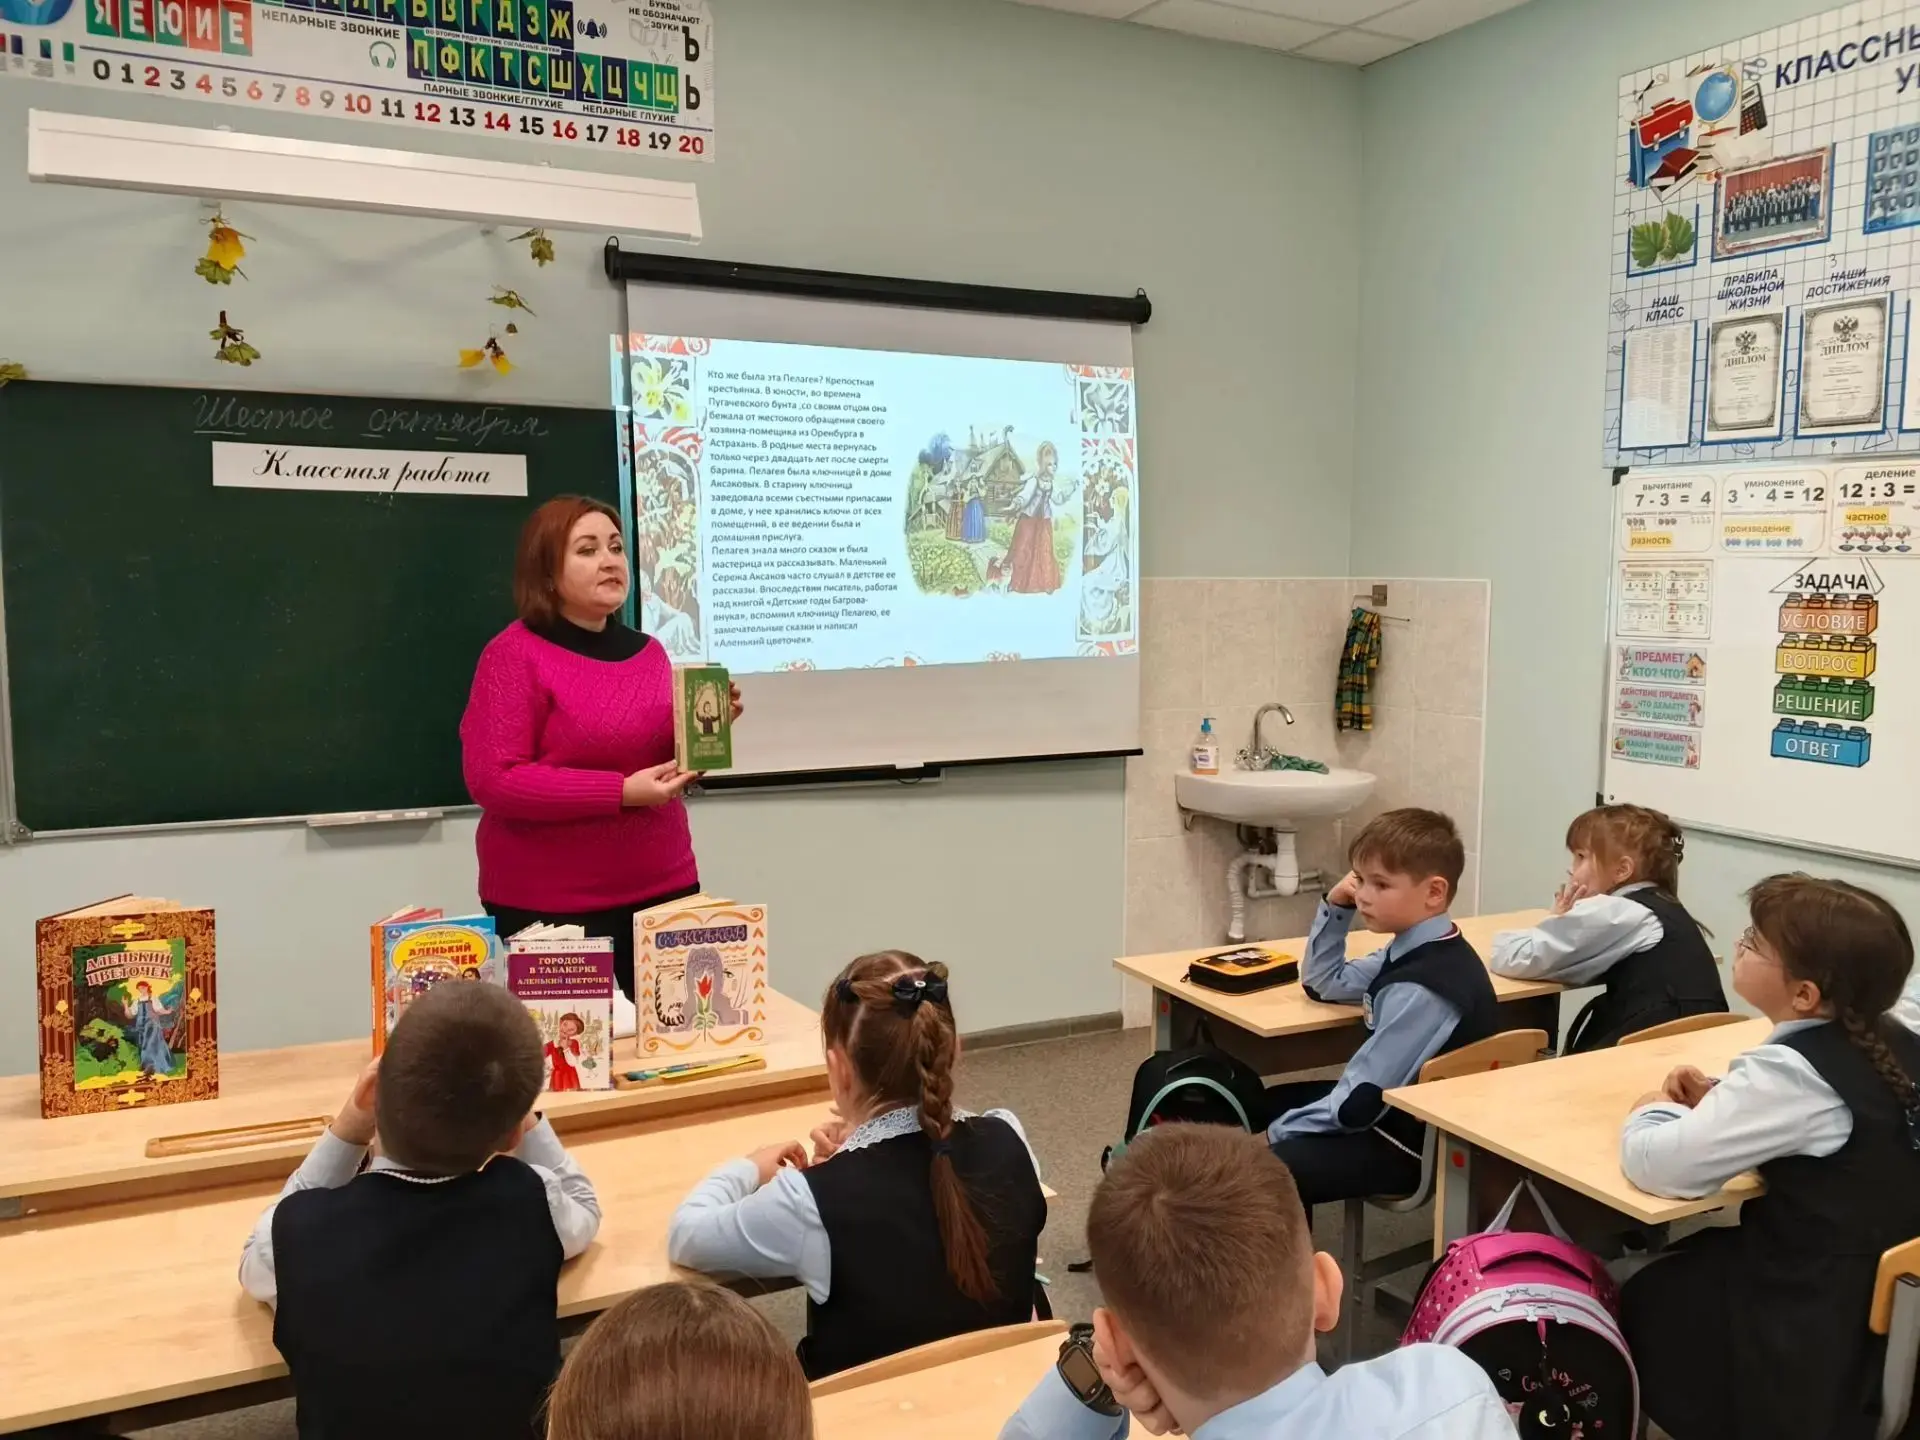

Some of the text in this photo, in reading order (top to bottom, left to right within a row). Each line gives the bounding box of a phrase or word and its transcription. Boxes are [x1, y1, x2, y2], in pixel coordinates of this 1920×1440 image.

[649, 0, 680, 11] БУКВЫ
[629, 7, 700, 24] НЕ ОБОЗНАЧАЮТ
[262, 9, 400, 39] НЕПАРНЫЕ ЗВОНКИЕ
[651, 21, 679, 32] ЗВУКИ
[682, 26, 700, 62] Ъ
[413, 40, 677, 106] П Ф К Т С Ш Х Ц Ч Щ
[1896, 62, 1920, 94] У
[424, 83, 563, 109] ПАРНЫЕ ЗВОНКИЕ/ГЛУХИЕ
[686, 75, 700, 110] Ь
[93, 59, 110, 80] 0
[121, 63, 134, 84] 1
[144, 66, 160, 87] 2
[170, 69, 186, 90] 3
[196, 74, 212, 94] 4
[222, 77, 237, 97] 5
[247, 80, 263, 100] 6
[272, 83, 286, 103] 7
[295, 86, 311, 106] 8
[320, 90, 334, 109] 9
[344, 92, 371, 114] 10
[380, 97, 405, 118] 11
[414, 102, 441, 123] 12
[450, 106, 475, 127] 13
[484, 111, 510, 131] 14
[520, 115, 544, 135] 15
[552, 119, 577, 140] 16
[586, 124, 609, 143] 17
[616, 128, 640, 147] 18
[648, 132, 671, 150] 19
[679, 135, 704, 154] 20
[583, 105, 676, 123] НЕПАРНЫЕ ГЛУХИЕ
[1724, 268, 1778, 287] ПРАВИЛА
[1830, 267, 1867, 283] НАШИ
[1717, 277, 1785, 300] ШКОЛЬНОЙ
[1806, 275, 1891, 299] ДОСТИЖЕНИЯ
[1652, 294, 1680, 308] НАШ
[1728, 295, 1771, 311] ЖИЗНИ
[1646, 306, 1684, 322] КЛАСС
[1820, 341, 1870, 357] ДИПЛОМ
[1724, 354, 1766, 368] ДИПЛОМ
[783, 374, 874, 385] Пелагея? Крепостная
[708, 386, 809, 398] крестьянка. юности,
[708, 398, 769, 407] Пугачевского
[193, 396, 549, 446] Шестое октября
[805, 415, 855, 424] обращения
[709, 427, 857, 438] хозяина-помещика Оренбурга
[709, 439, 877, 452] Астрахань. родные вернулась
[771, 455, 813, 463] двадцать
[253, 450, 491, 491] Классная работа
[710, 466, 861, 476] барина. Пелагея ключницей
[1864, 469, 1916, 480] деление
[710, 479, 852, 490] Аксаковых. старину ключница
[1643, 481, 1693, 491] вычитание
[1744, 479, 1805, 490] умножение
[1840, 482, 1895, 498] 12 3
[711, 495, 764, 503] заведовала
[845, 495, 892, 503] припасами
[1635, 491, 1711, 507] 7 3 4
[1727, 487, 1825, 504] 3 4 12
[774, 509, 821, 517] хранились
[1846, 513, 1887, 521] частное
[711, 520, 829, 530] помещений, ведении
[1724, 524, 1791, 534] произведение
[711, 534, 804, 543] домашняя прислуга.
[1631, 536, 1672, 546] разность
[712, 546, 750, 554] Пелагея
[712, 557, 887, 570] мастерица рассказывать. Маленький
[712, 572, 885, 583] Сережа Аксаков детстве
[1794, 573, 1869, 591] ЗАДАЧА
[713, 583, 897, 596] рассказы. Впоследствии писатель, работая
[766, 597, 808, 607] «Детские
[713, 613, 748, 622] внука»,
[797, 610, 839, 619] ключницу
[841, 608, 879, 618] Пелагею,
[1781, 613, 1866, 631] УСЛОВИЕ
[714, 625, 784, 633] замечательные
[714, 636, 814, 646] «Аленький цветочек».
[1635, 651, 1684, 664] ПРЕДМЕТ
[1783, 653, 1858, 673] ВОПРОС
[1633, 667, 1686, 679] КТО? ЧТО?
[1620, 687, 1698, 700] ДЕЙСТВИЕ ПРЕДМЕТА
[1775, 693, 1861, 715] РЕШЕНИЕ
[1619, 728, 1692, 742] ПРИЗНАК ПРЕДМЕТА
[1785, 738, 1841, 758] ОТВЕТ
[408, 942, 471, 956] АЛЕНЬКИЙ
[538, 957, 585, 966] ГОРОДОК
[87, 966, 170, 986] ЦВЕТОЧЕК
[538, 966, 597, 974] ТАБАКЕРКЕ
[517, 977, 609, 985] АЛЕНЬКИЙ ЦВЕТОЧЕК
